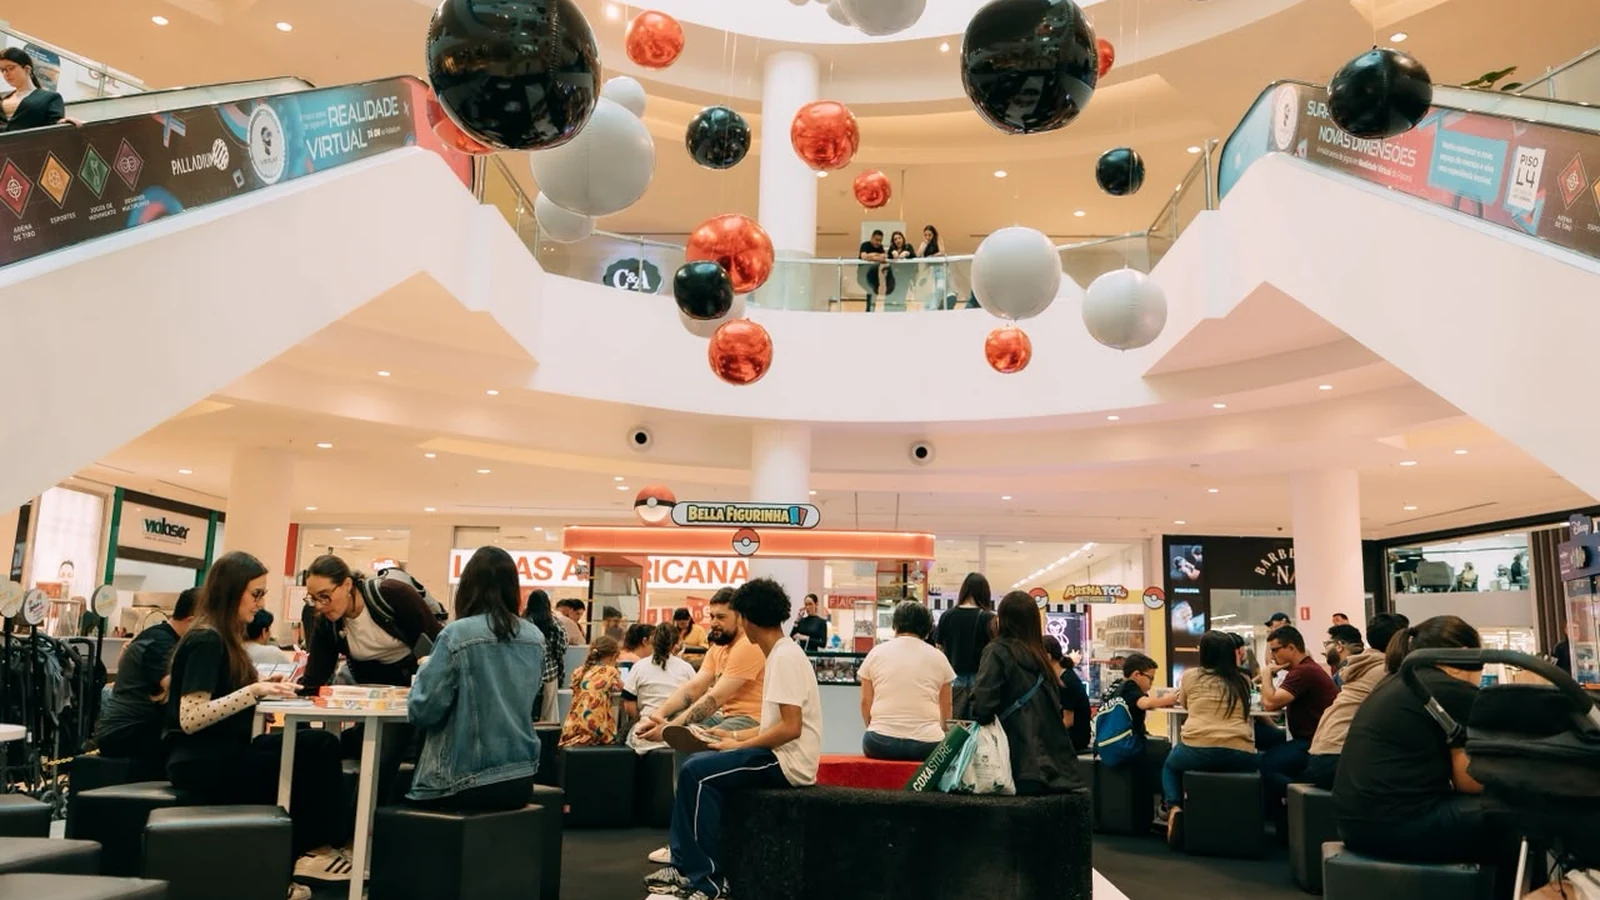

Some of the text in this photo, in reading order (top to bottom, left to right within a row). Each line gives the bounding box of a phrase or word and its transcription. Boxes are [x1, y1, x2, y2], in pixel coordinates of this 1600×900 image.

[327, 96, 400, 129] REALIDADE
[305, 128, 368, 161] VIRTUAL
[1318, 126, 1352, 147] NOVAS
[171, 152, 217, 176] PALLADIUM
[1520, 154, 1539, 168] PISO
[1516, 168, 1536, 189] L4
[88, 208, 117, 221] MOVIMENTO
[90, 202, 114, 214] JOGOS DE
[50, 212, 77, 225] ESPORTES
[13, 223, 33, 233] ARENA
[13, 231, 36, 242] DE TIRO
[613, 268, 651, 290] C&A
[687, 504, 790, 524] BELLA FIGURINHA
[1063, 585, 1123, 600] ARENA TCG
